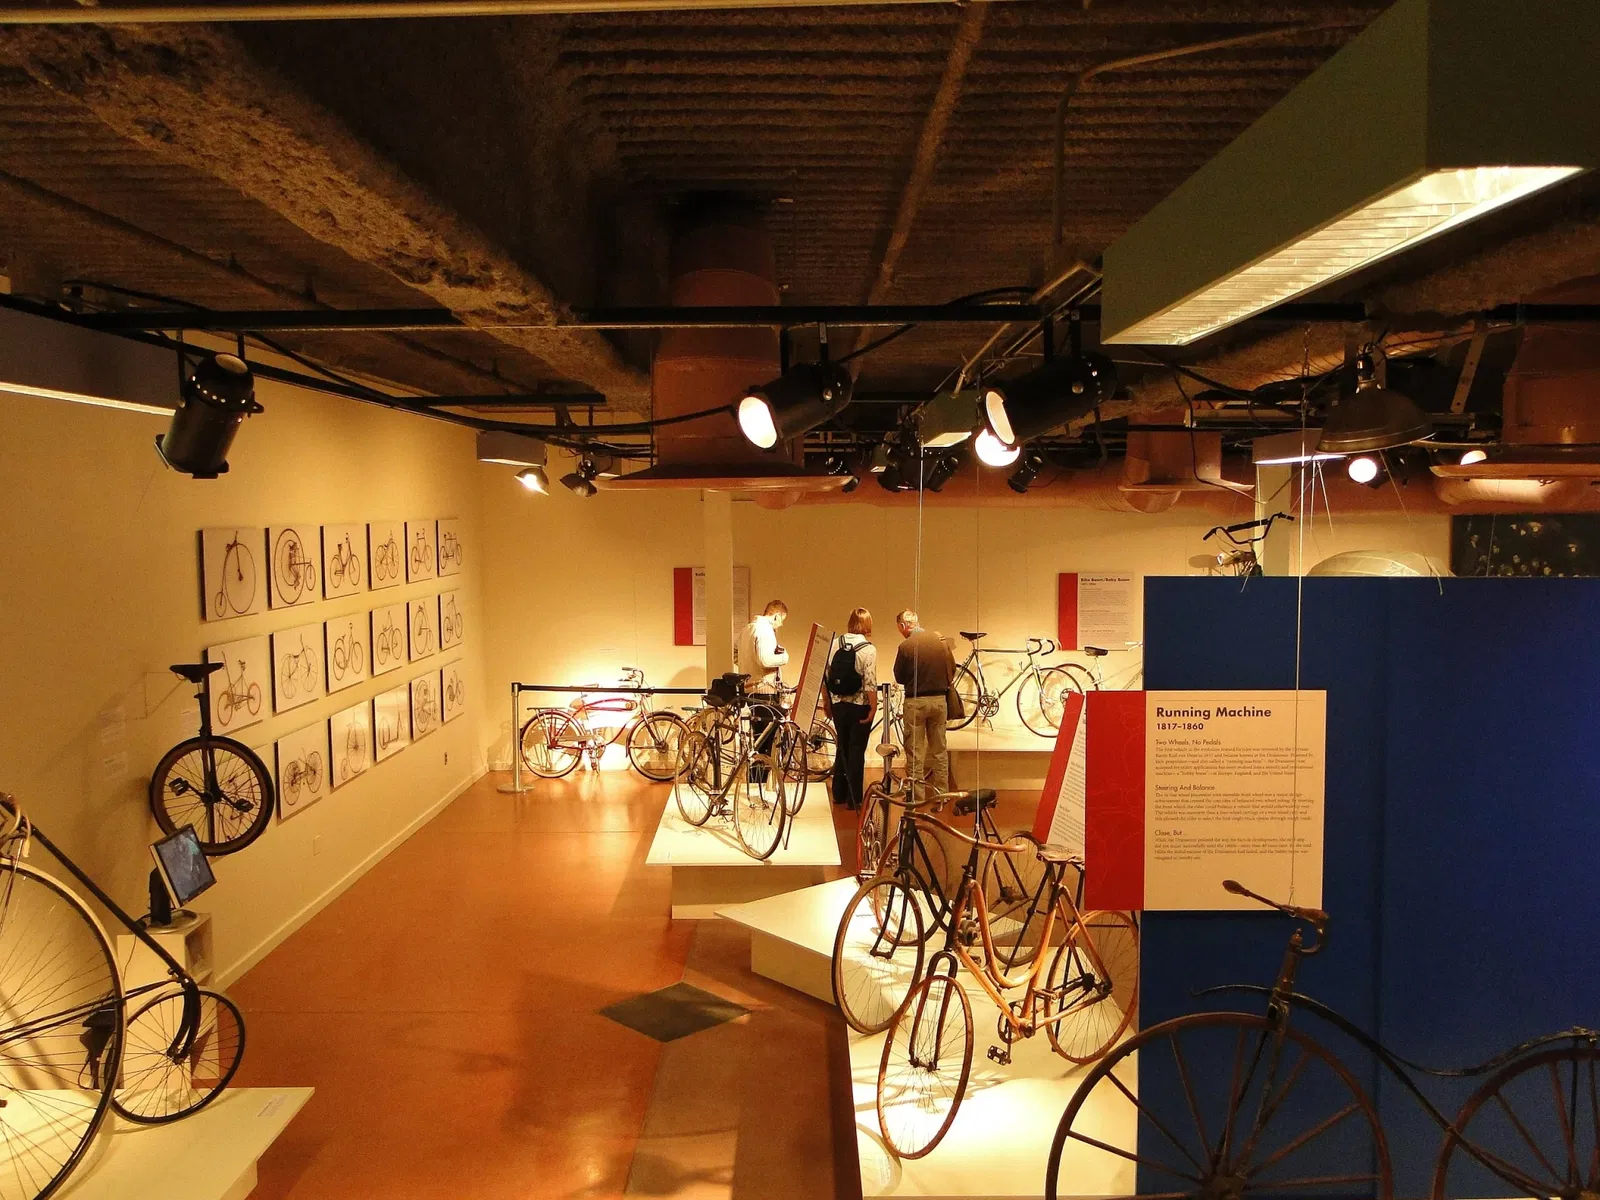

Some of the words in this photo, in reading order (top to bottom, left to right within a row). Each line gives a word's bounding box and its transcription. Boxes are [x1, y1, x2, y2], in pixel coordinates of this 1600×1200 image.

[1156, 707, 1211, 720] Running
[1216, 706, 1272, 717] Machine
[1155, 784, 1178, 792] Steering
